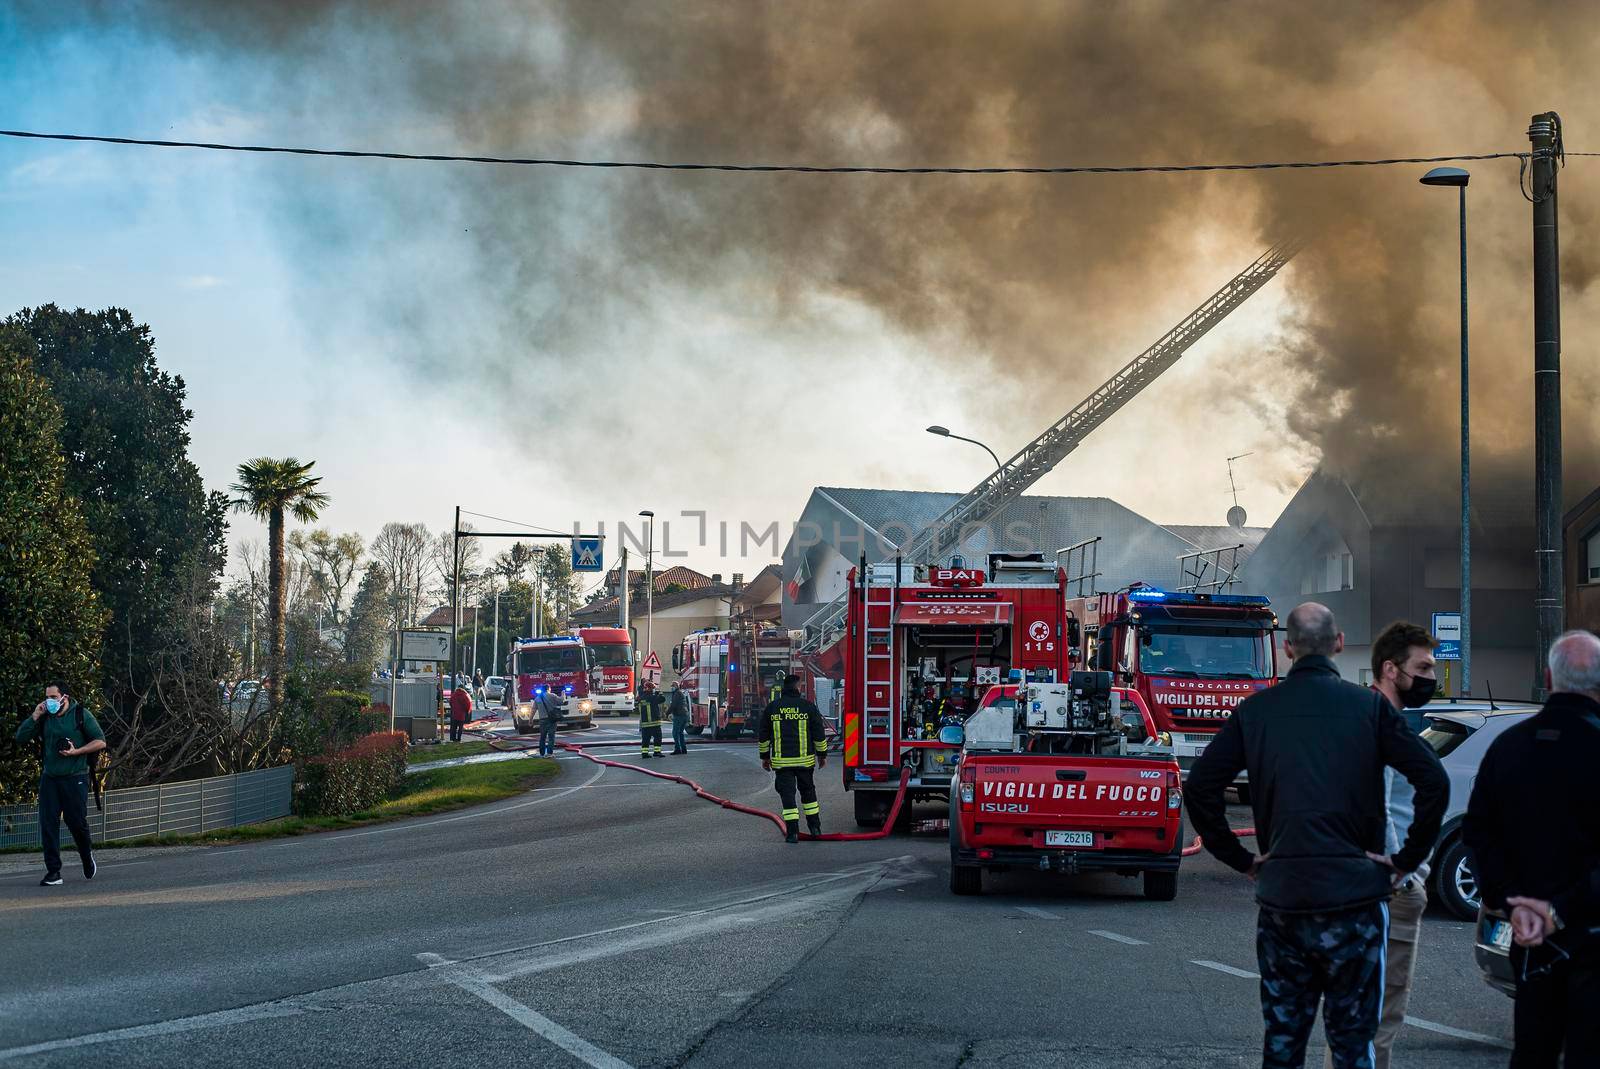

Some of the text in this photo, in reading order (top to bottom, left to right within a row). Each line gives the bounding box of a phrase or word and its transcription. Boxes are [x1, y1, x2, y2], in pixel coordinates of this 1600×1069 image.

[938, 570, 975, 580] BAI
[1170, 681, 1250, 689] EUROCARGO
[1155, 693, 1193, 705] VIGILI
[1196, 695, 1218, 706] DEL
[1186, 708, 1233, 719] IVECO
[985, 766, 1020, 774] COUNTRY
[983, 781, 1161, 801] VIGILI DEL FUOCO
[981, 802, 1029, 813] ISUZU
[1048, 832, 1091, 844] VF 26216
